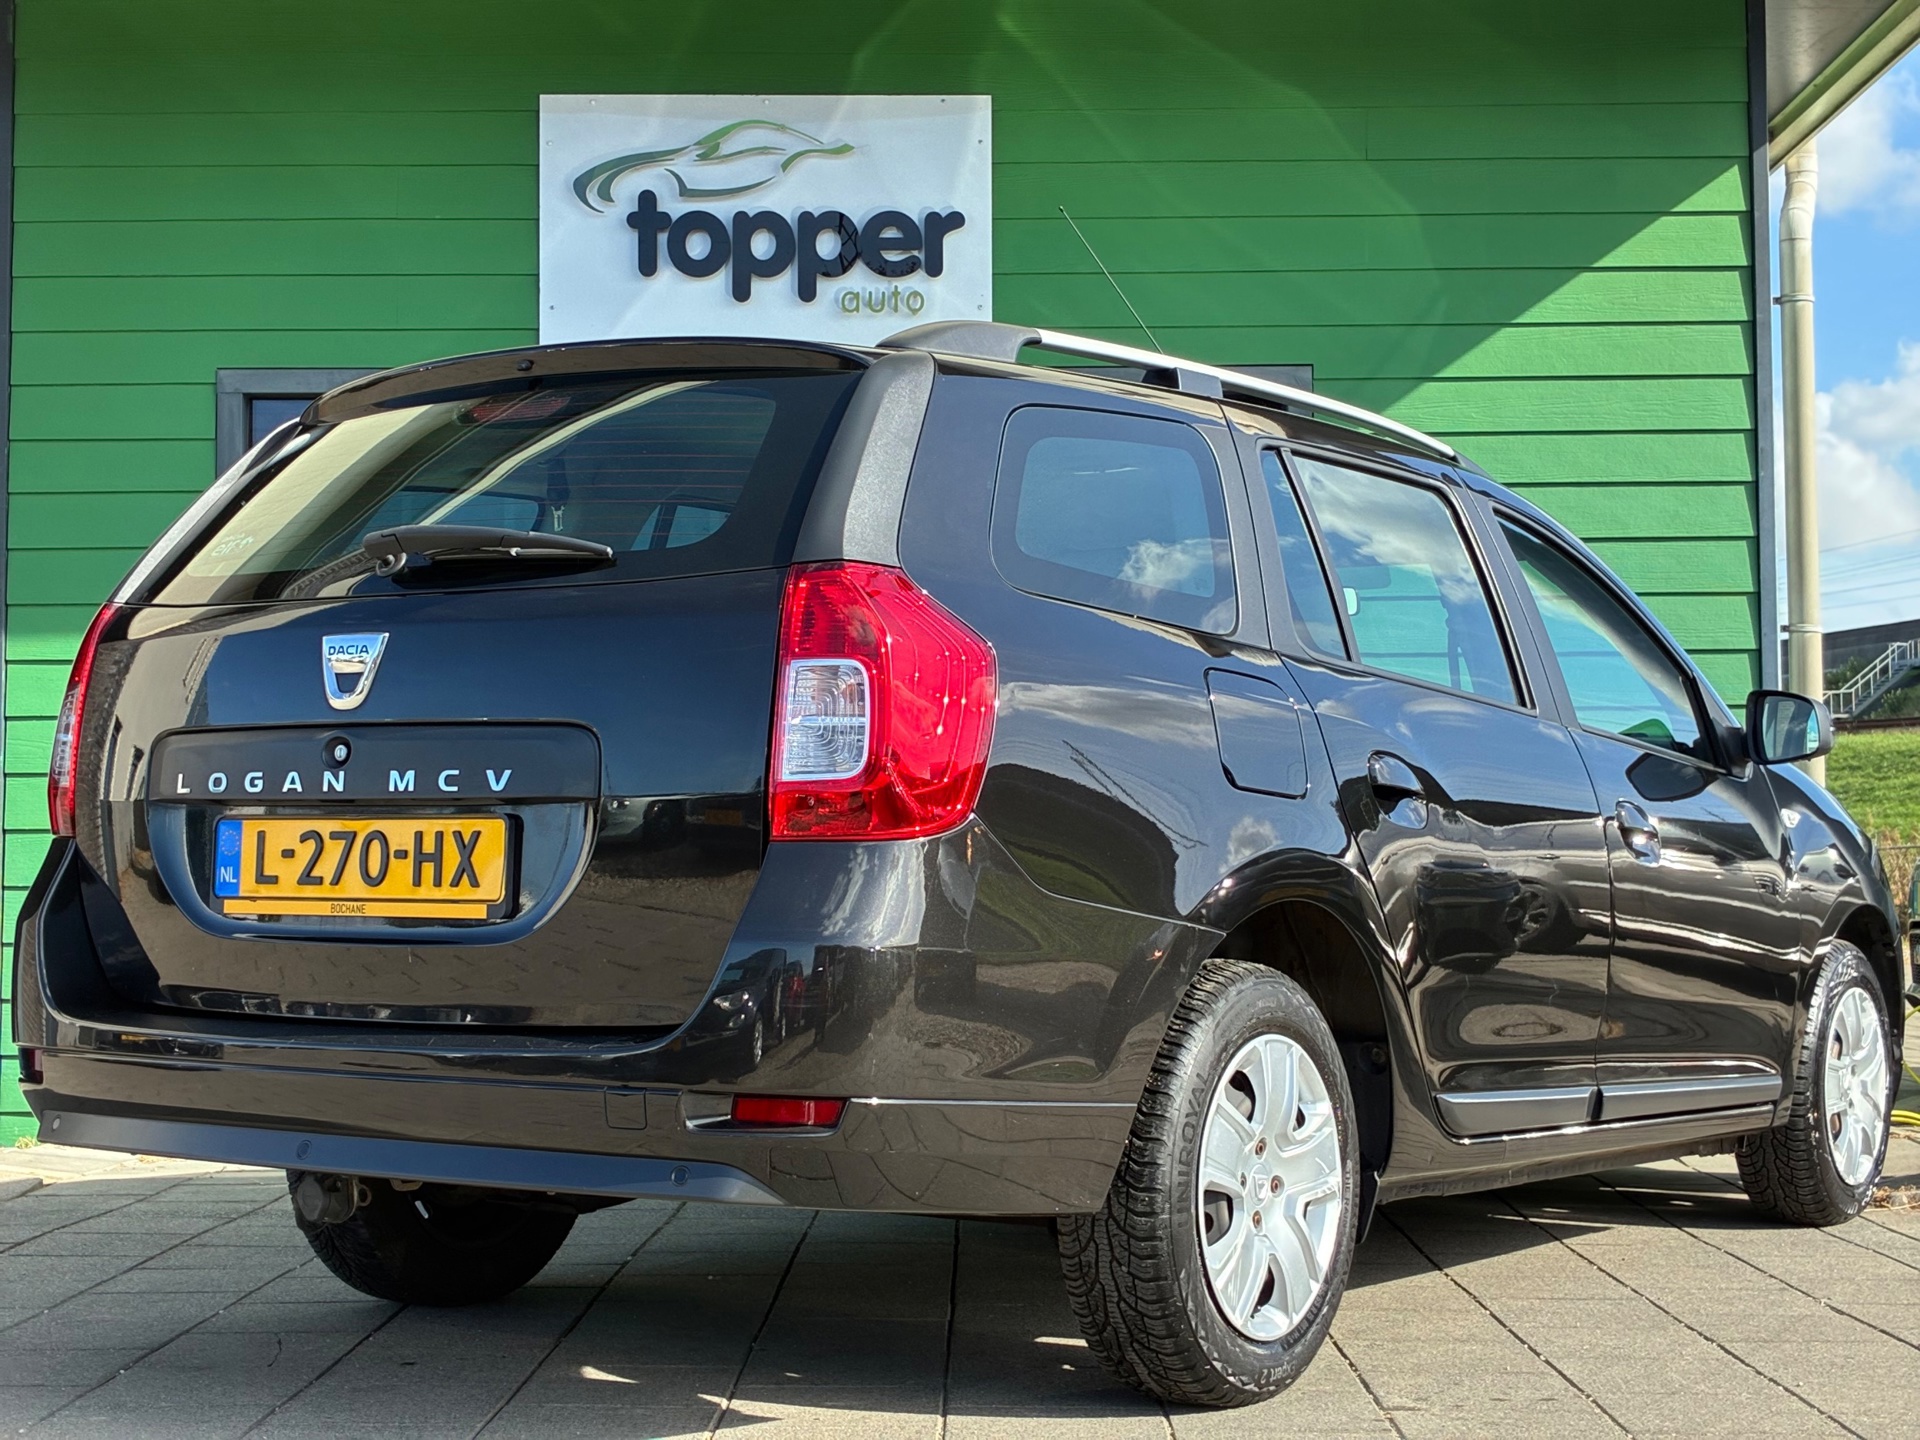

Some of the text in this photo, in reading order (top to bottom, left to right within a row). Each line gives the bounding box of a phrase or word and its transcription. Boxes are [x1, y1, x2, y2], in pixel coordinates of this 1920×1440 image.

[626, 189, 966, 303] topper
[840, 285, 925, 314] auto
[327, 644, 370, 656] DACIA
[176, 769, 512, 794] LOGAN MCV
[220, 829, 482, 888] NL L-270-HX
[330, 903, 367, 915] BOCHANE
[1176, 1072, 1209, 1229] UNIROYAL
[1260, 1361, 1297, 1384] Expert 2
